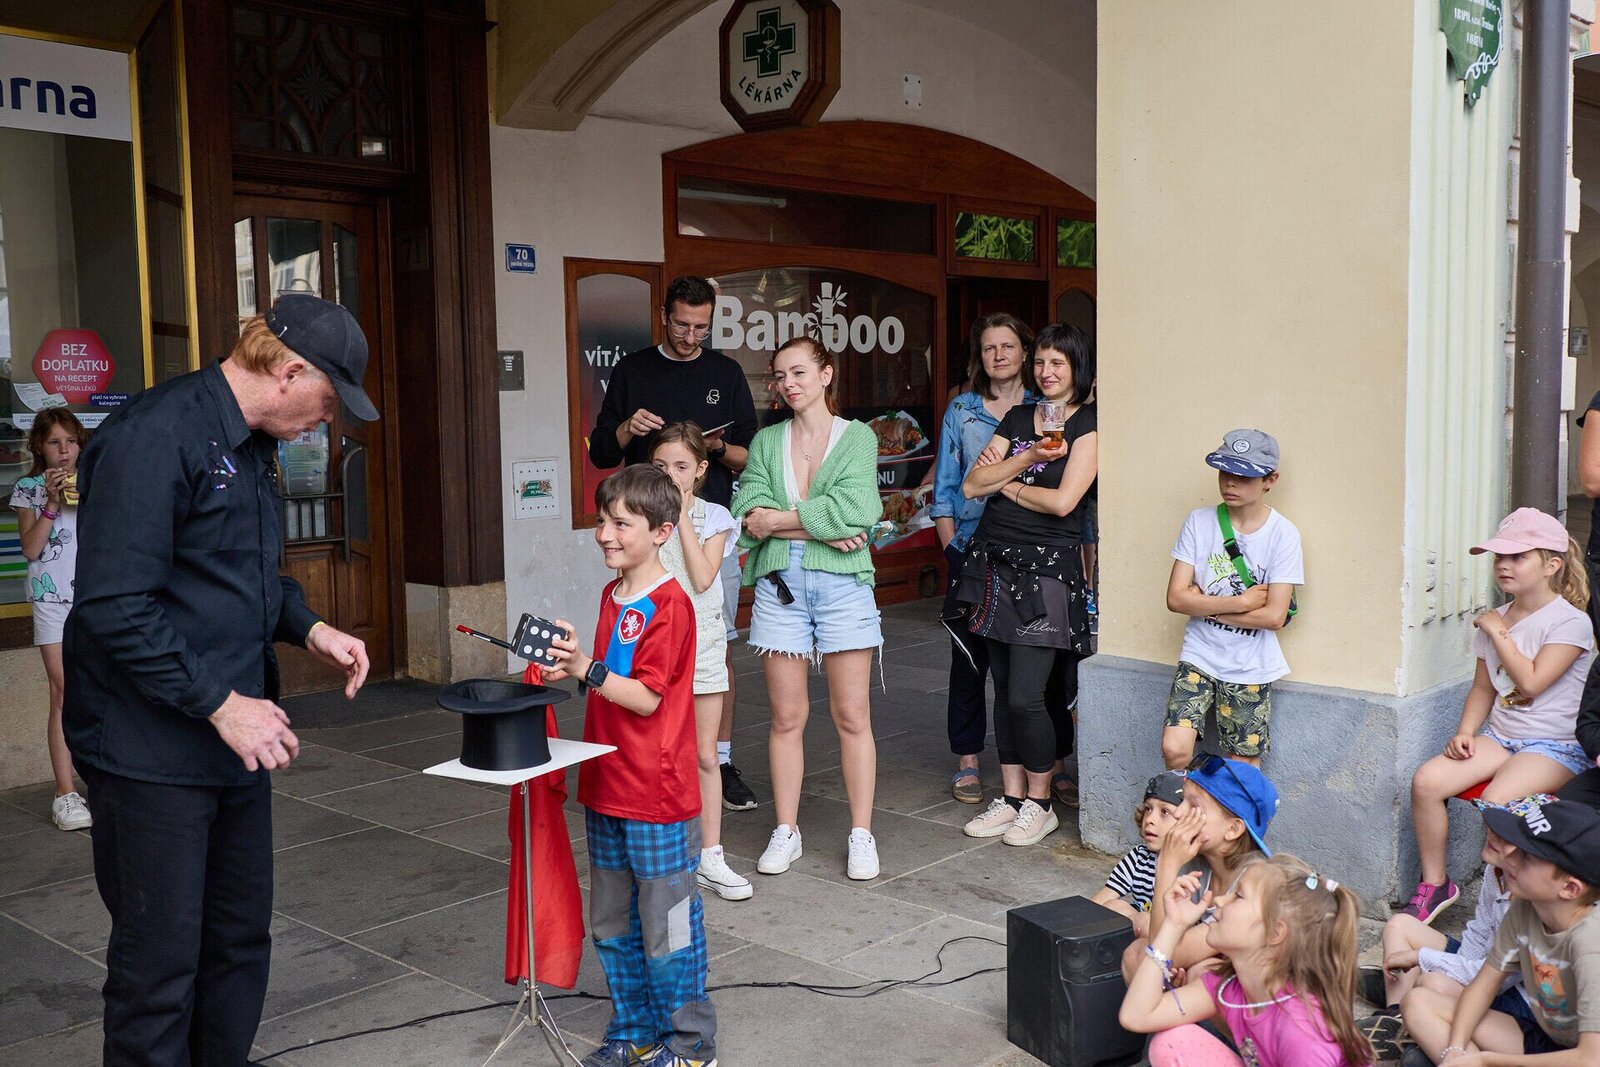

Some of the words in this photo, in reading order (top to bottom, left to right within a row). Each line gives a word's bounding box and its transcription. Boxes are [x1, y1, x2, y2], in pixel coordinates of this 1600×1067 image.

[738, 69, 801, 103] LÉKÁRNA
[0, 78, 97, 119] rna
[515, 248, 529, 261] 70
[711, 282, 905, 355] Bamboo
[61, 343, 88, 356] BEZ
[584, 345, 630, 367] VÍTÁ
[41, 359, 109, 372] DOPLATKU
[54, 374, 66, 382] NA
[68, 374, 97, 383] RECEPT
[56, 384, 81, 392] VĚTŠINA
[876, 471, 896, 486] NU
